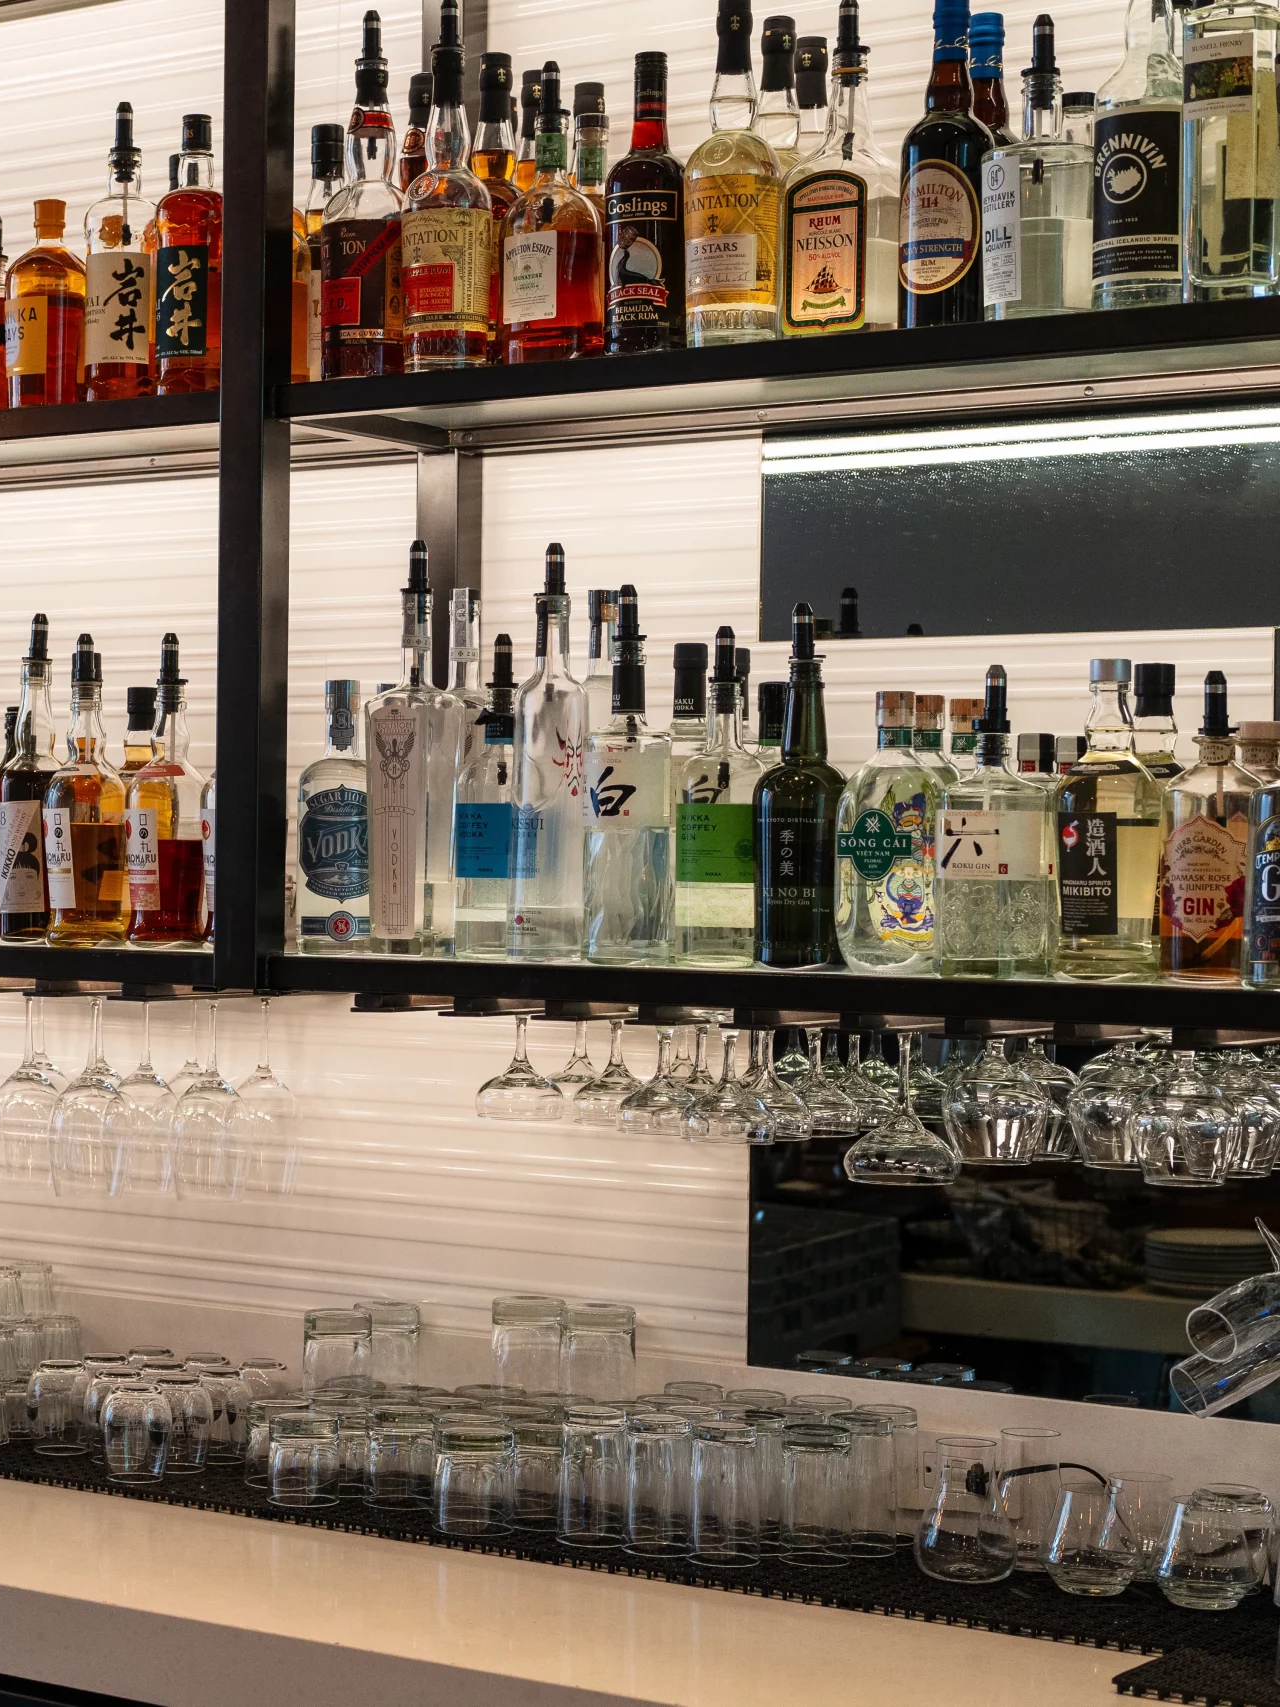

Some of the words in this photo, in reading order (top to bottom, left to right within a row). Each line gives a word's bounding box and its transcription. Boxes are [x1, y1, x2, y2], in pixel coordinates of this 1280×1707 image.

[1192, 42, 1218, 52] RUSSELL
[1220, 40, 1244, 48] HENRY
[636, 89, 662, 98] Goslings
[725, 178, 748, 191] Rum
[904, 183, 964, 206] HAMILTON
[984, 191, 1015, 205] REYKJAVIK
[608, 197, 668, 216] Goslings
[685, 193, 759, 215] PLANTATION
[921, 196, 939, 208] 114
[984, 200, 1015, 213] DISTILLERY
[808, 215, 841, 230] RHUM
[340, 227, 356, 238] Rum
[985, 227, 1012, 244] DILL
[796, 233, 853, 252] NEISSON
[1117, 236, 1150, 244] ICELANDIC
[505, 243, 531, 262] APPLETON
[532, 242, 554, 256] ESTATE
[694, 246, 699, 255] 3
[702, 242, 738, 253] STARS
[919, 244, 963, 253] STRENGTH
[985, 241, 1012, 253] AQUAVIT
[513, 273, 542, 281] SIGNATURE
[610, 288, 635, 300] BLACK
[637, 287, 660, 297] SEAL
[103, 259, 146, 351] 岩井
[615, 304, 654, 313] BERMUDA
[612, 314, 637, 322] BLACK
[638, 312, 659, 320] RUM
[359, 329, 385, 337] GUYANA
[377, 722, 412, 730] HOLYSTONE
[590, 766, 636, 818] 白
[310, 792, 342, 808] SUGAR
[324, 804, 360, 816] Distillery
[0, 811, 6, 825] 8
[512, 818, 544, 830] KISSUI
[681, 814, 710, 822] NIKKA
[681, 833, 696, 841] GIN
[840, 837, 876, 847] SÔNG
[883, 837, 907, 847] CÁI
[940, 817, 999, 869] 六
[1086, 819, 1107, 876] 造酒人
[1175, 837, 1191, 853] HERB
[1193, 835, 1227, 854] GARDEN
[780, 829, 794, 876] 季の美
[1, 848, 16, 880] IKIKKO
[311, 880, 354, 892] HANDCRAFTED
[1062, 887, 1111, 896] MIKIBITO
[1186, 884, 1221, 892] JUNIPER
[763, 888, 773, 897] KI
[778, 888, 797, 897] NO
[803, 888, 816, 898] BI
[1183, 898, 1215, 915] GIN
